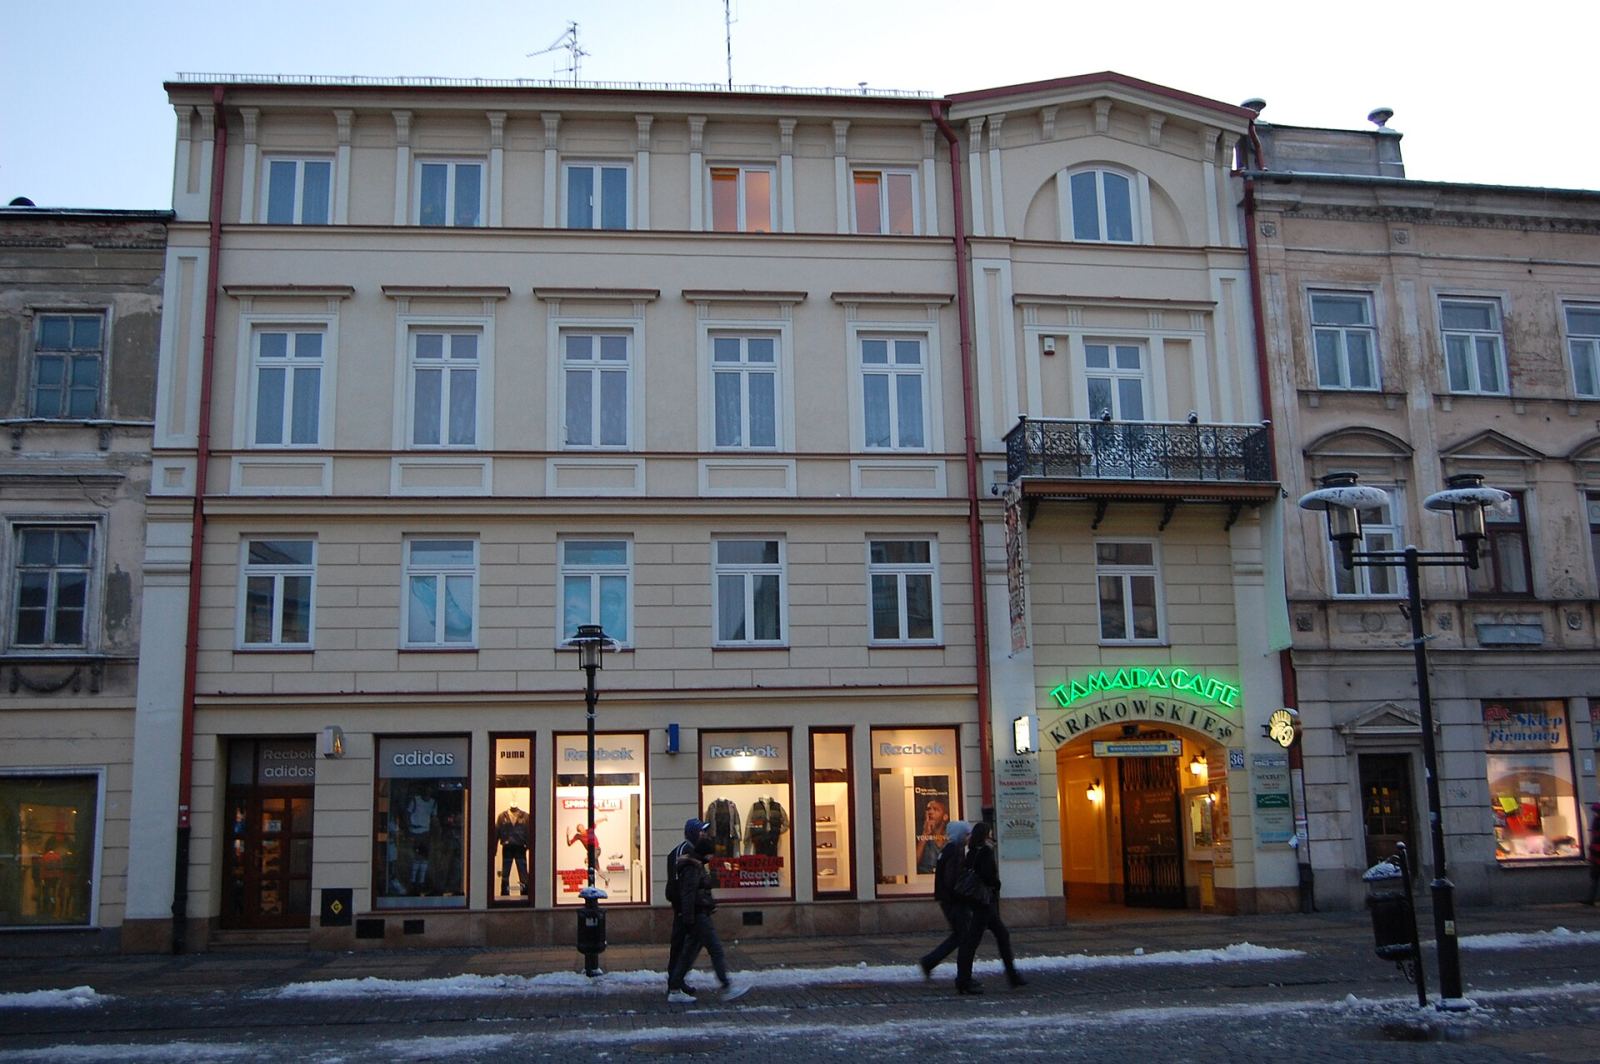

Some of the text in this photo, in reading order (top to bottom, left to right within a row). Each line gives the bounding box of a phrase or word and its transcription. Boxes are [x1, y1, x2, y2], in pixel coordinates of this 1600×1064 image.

[1050, 668, 1239, 708] TAMARA CAFE
[1050, 700, 1232, 744] KRAKOWSKIE 36
[1489, 729, 1560, 744] Firmowy
[500, 750, 525, 759] PUMA
[710, 745, 779, 759] Reebok
[880, 743, 945, 756] Reebok
[393, 750, 455, 766] adidas
[1230, 754, 1244, 765] 36
[264, 764, 315, 777] adidas
